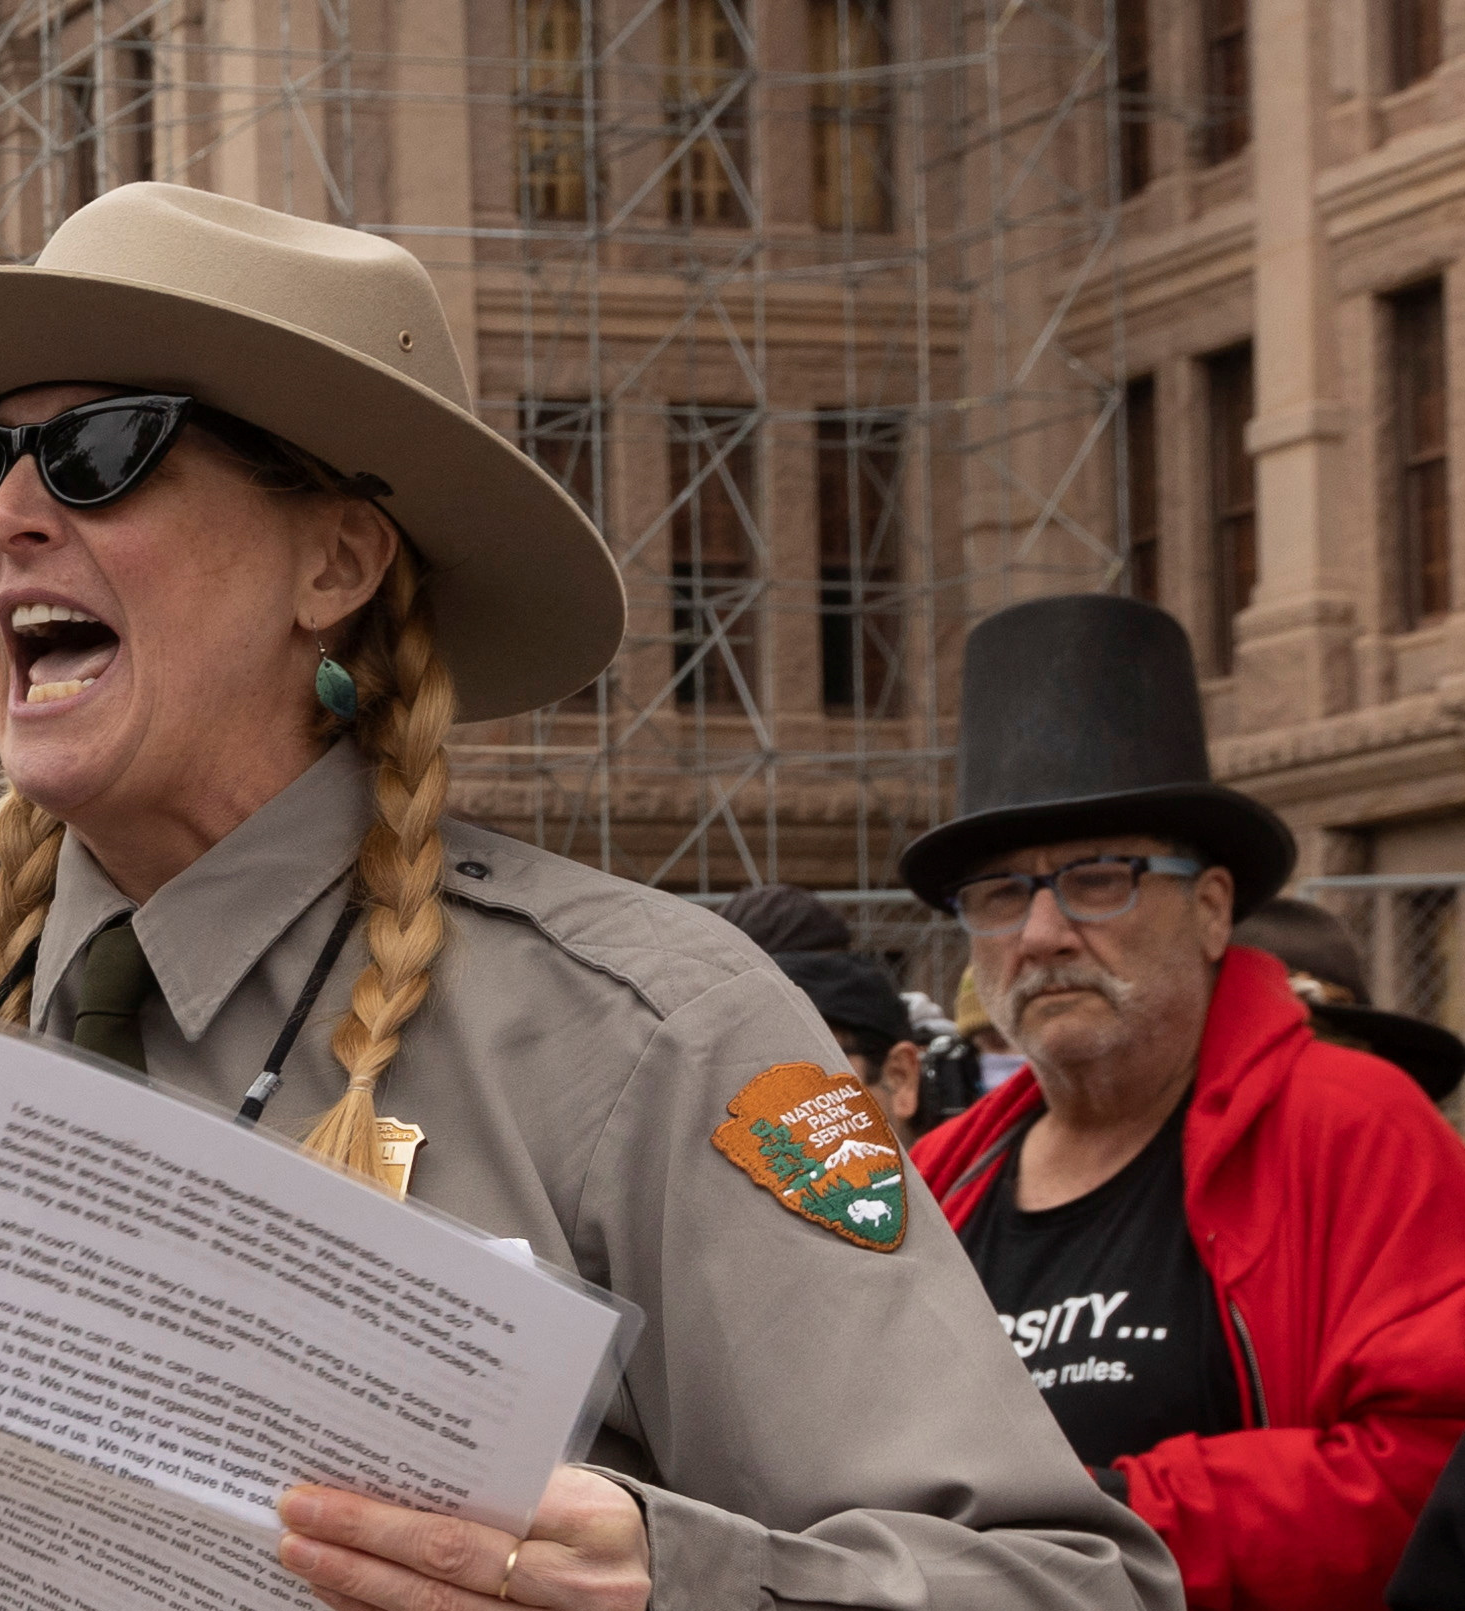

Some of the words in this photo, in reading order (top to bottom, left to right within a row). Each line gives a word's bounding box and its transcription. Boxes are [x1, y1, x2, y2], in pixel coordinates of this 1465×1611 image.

[779, 1084, 862, 1126] NATIONAL
[806, 1103, 853, 1130] PARK
[808, 1111, 873, 1149] SERVICE
[1060, 1356, 1135, 1385] rules.
[41, 1581, 72, 1603] Who
